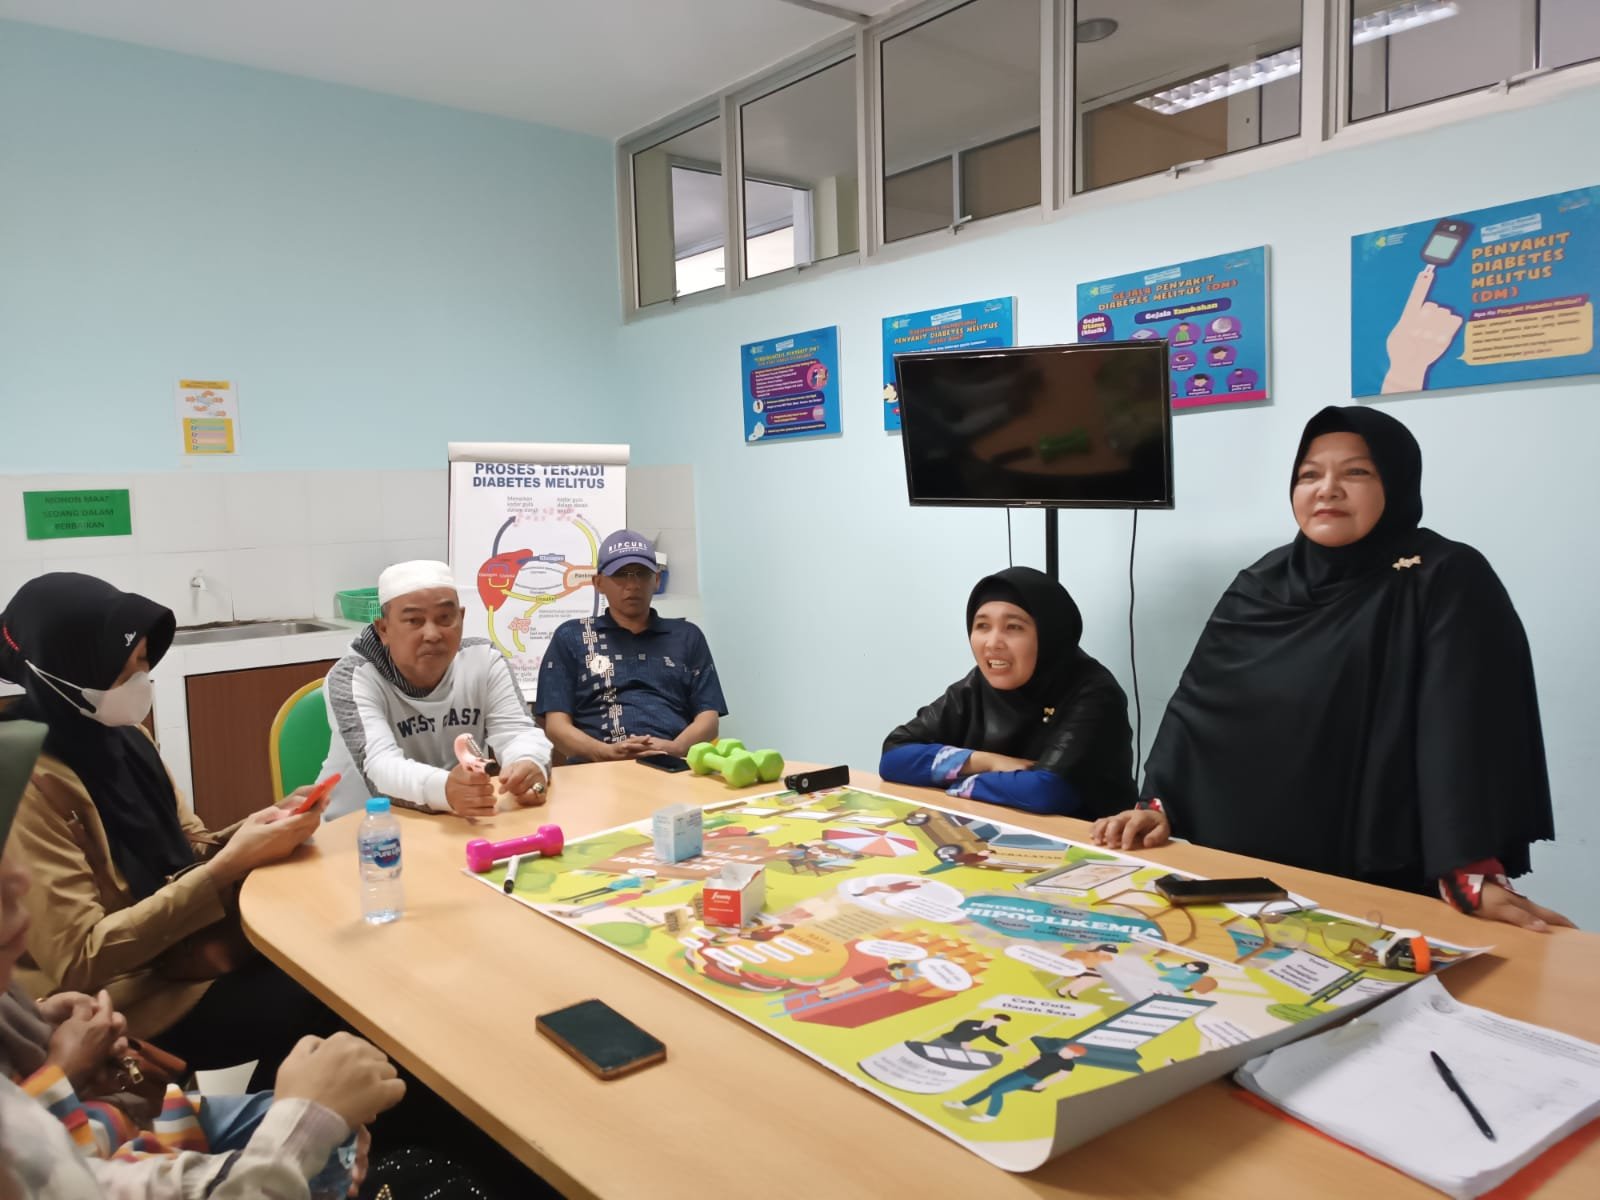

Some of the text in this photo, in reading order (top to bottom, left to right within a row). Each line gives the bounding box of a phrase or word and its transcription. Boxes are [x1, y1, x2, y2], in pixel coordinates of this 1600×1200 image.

[1472, 232, 1570, 259] PENYAKIT
[1472, 248, 1564, 274] DIABETES
[1112, 287, 1152, 300] GEJALA
[1155, 274, 1215, 292] PENYAKIT
[1472, 266, 1552, 288] MELITUS
[1098, 296, 1148, 312] DIABETES
[1153, 287, 1201, 302] MELITUS
[1472, 287, 1519, 303] (DM)
[1145, 302, 1218, 320] Gejala Tambahan
[475, 463, 605, 477] PROSES TERJADI
[473, 477, 605, 489] DIABETES MELITUS
[397, 714, 436, 739] WEST
[962, 907, 1162, 937] HIPOGLIKEMIA
[1002, 1002, 1042, 1013] Darah
[1040, 1001, 1072, 1010] Gula
